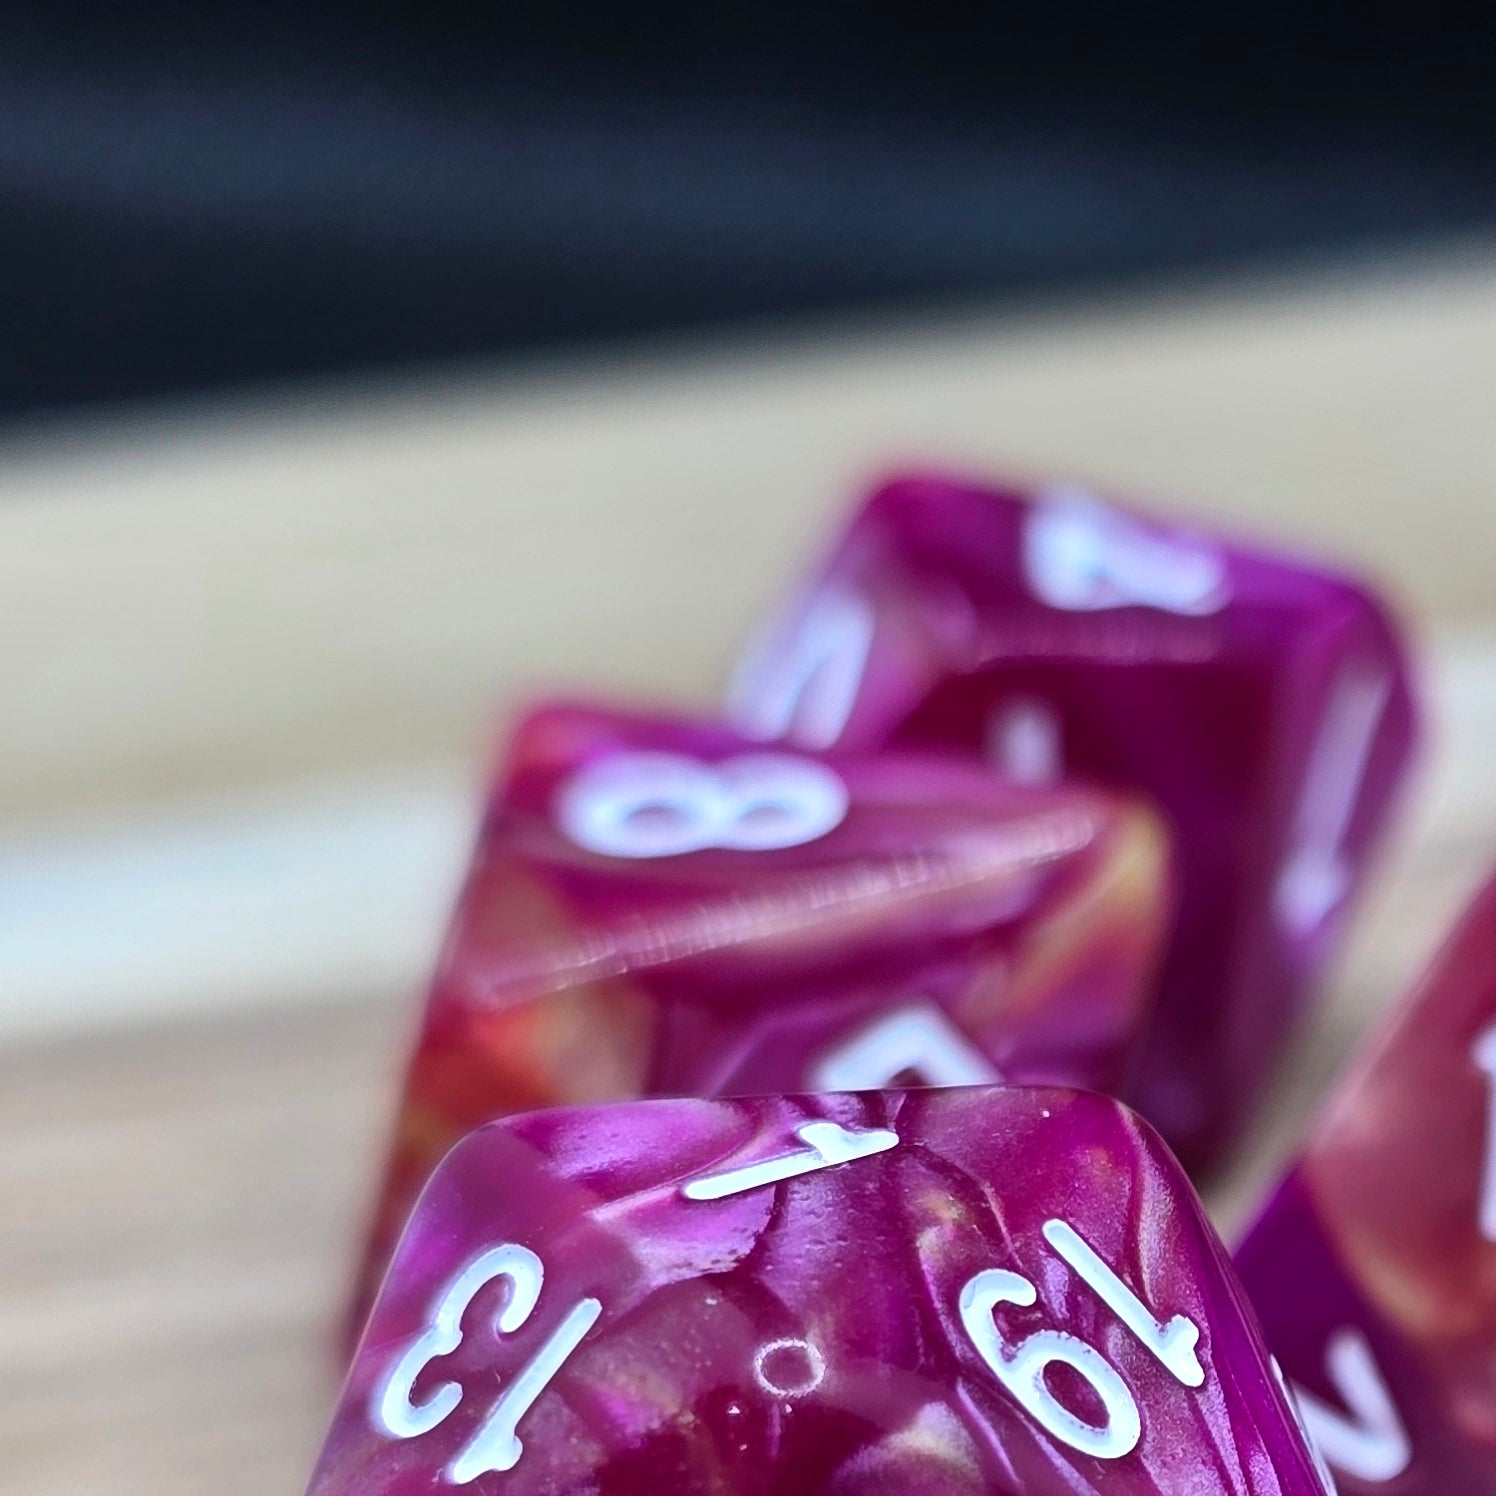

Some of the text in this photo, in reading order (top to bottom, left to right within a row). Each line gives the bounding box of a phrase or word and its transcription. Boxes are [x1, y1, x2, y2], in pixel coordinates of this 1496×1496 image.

[557, 750, 850, 862] 8
[380, 1243, 601, 1485] 13
[958, 1219, 1204, 1460] 19
